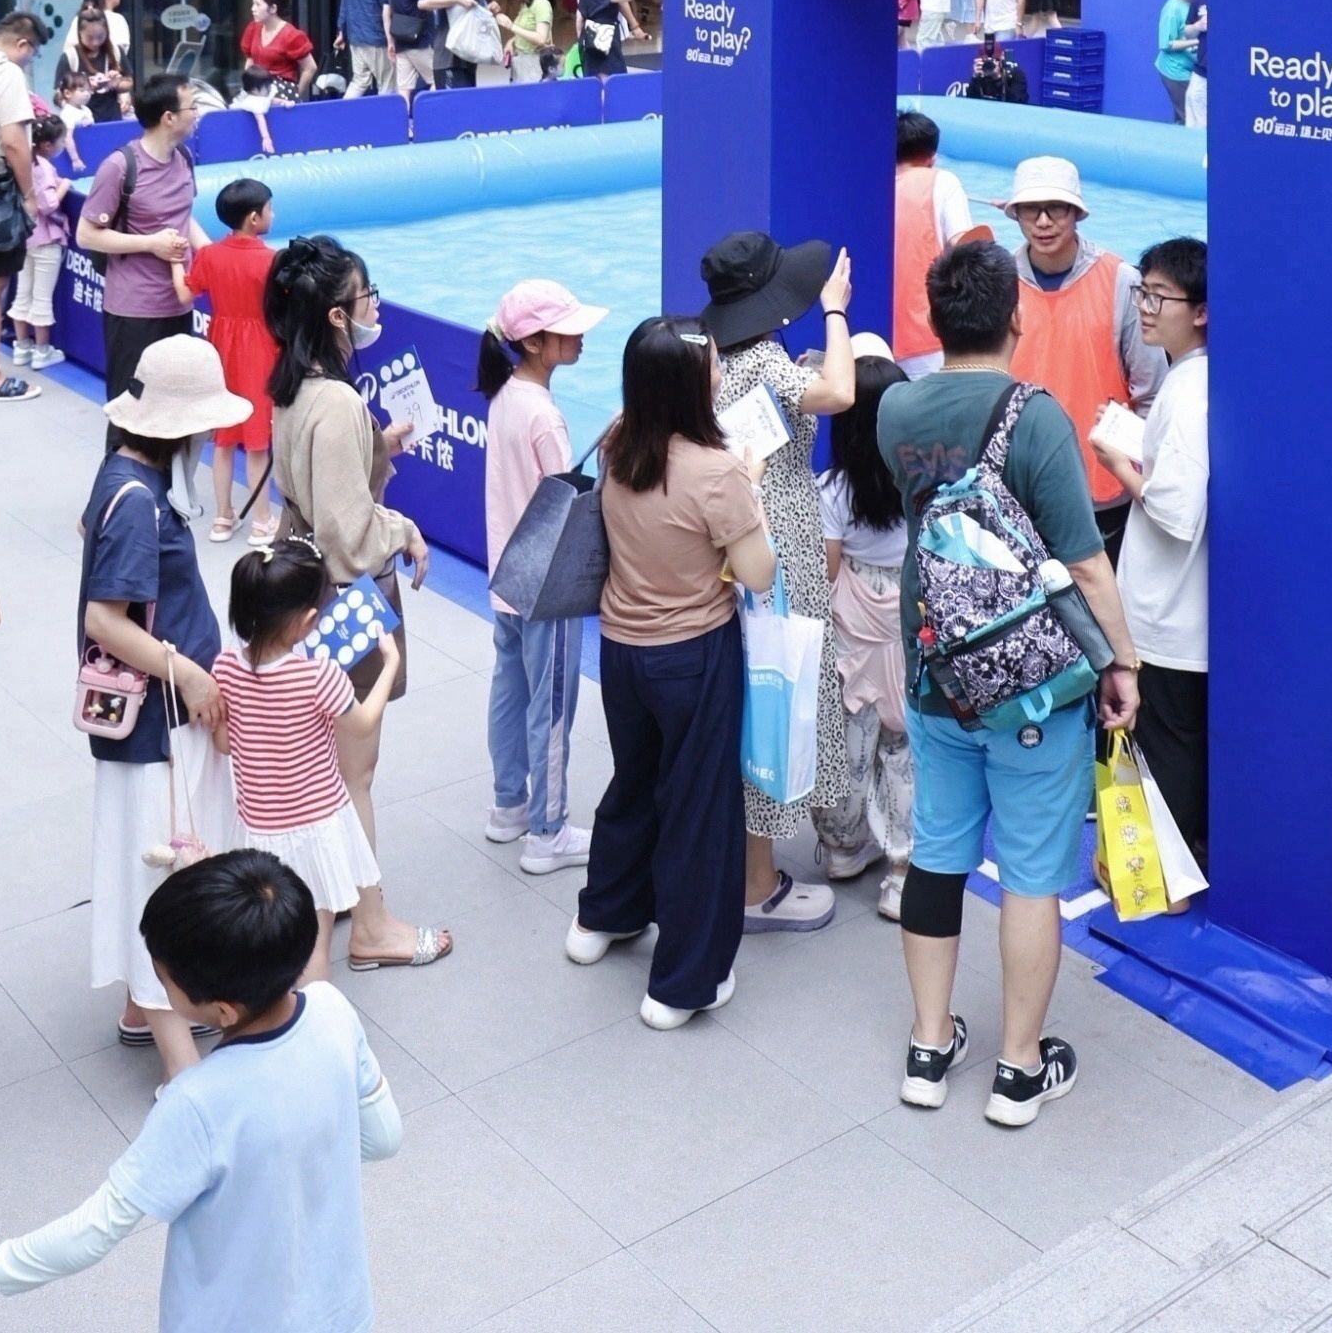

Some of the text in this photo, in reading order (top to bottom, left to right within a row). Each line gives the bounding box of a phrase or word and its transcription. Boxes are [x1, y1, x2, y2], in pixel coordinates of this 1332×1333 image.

[695, 26, 752, 56] to play?
[1269, 87, 1291, 108] to
[73, 278, 104, 313] 迪卡侬
[407, 435, 454, 472] 卡侬
